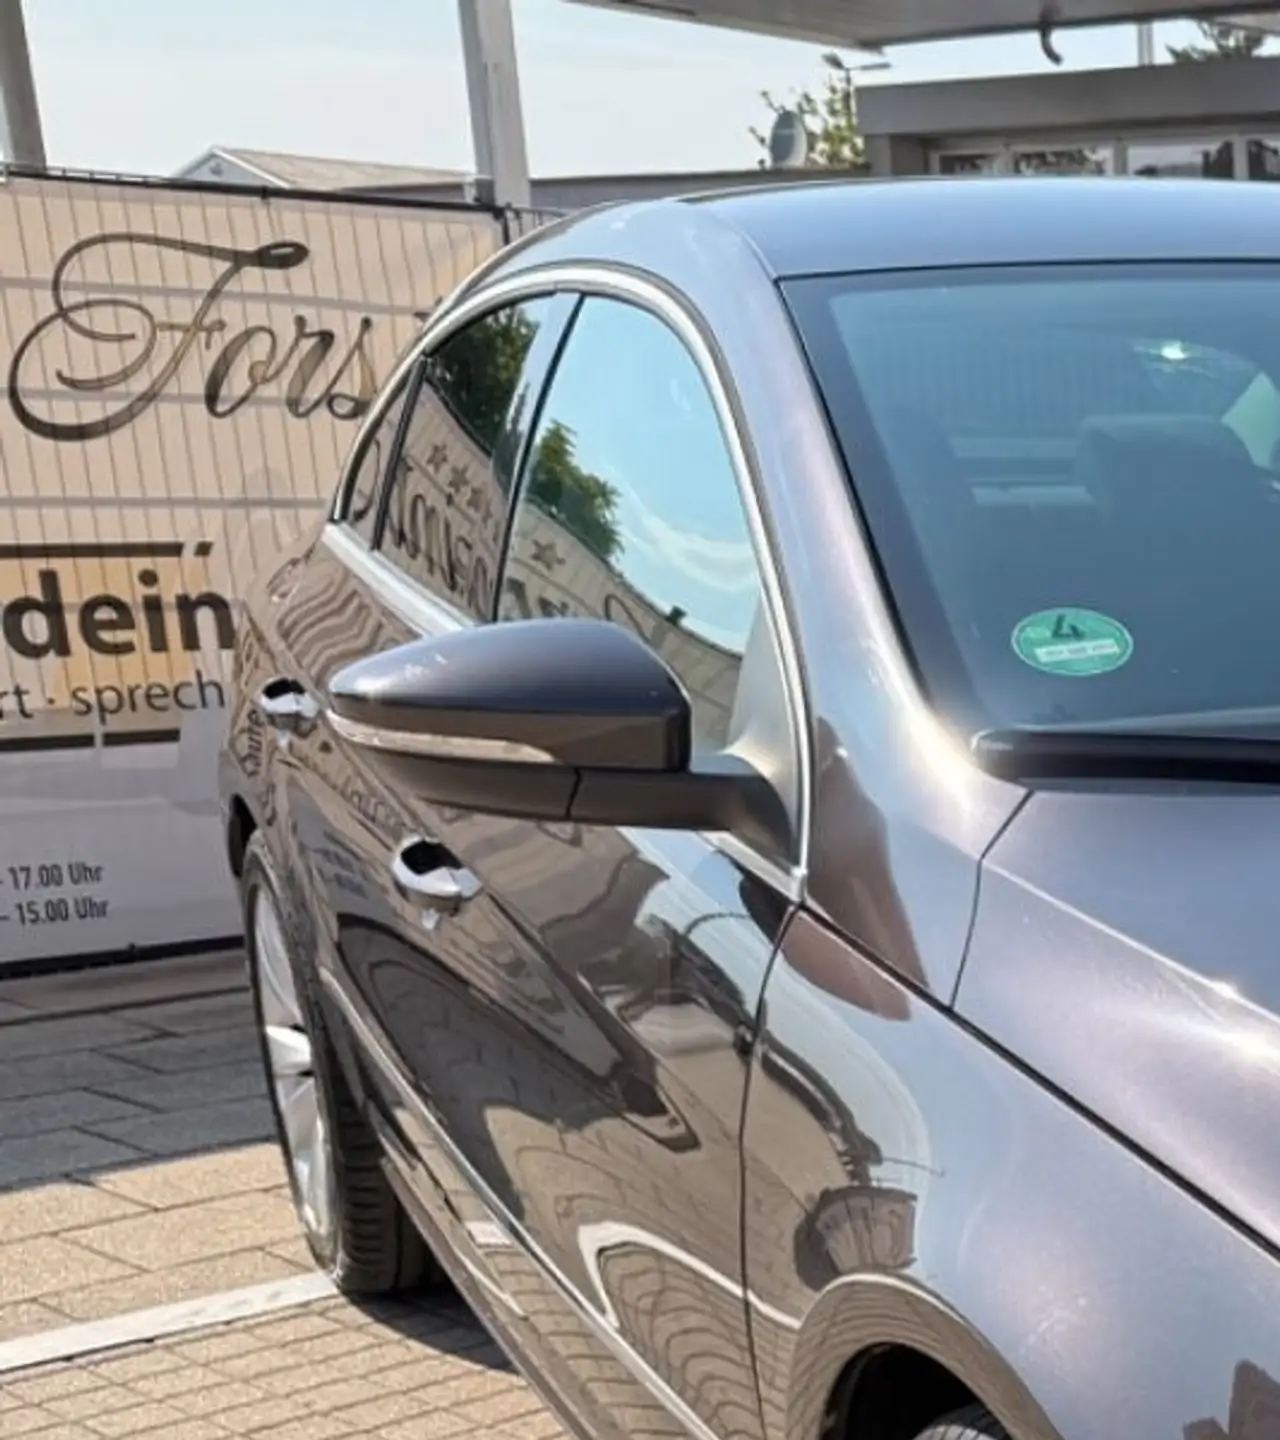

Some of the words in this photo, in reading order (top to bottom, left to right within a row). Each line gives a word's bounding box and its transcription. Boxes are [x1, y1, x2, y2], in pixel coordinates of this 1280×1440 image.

[10, 231, 380, 442] Fors
[3, 569, 235, 660] dein
[1052, 614, 1084, 638] 4
[71, 669, 226, 726] sprech
[8, 864, 63, 890] 17.00
[68, 861, 104, 886] Uhr
[15, 898, 69, 926] 15.00
[73, 896, 108, 920] Uhr
